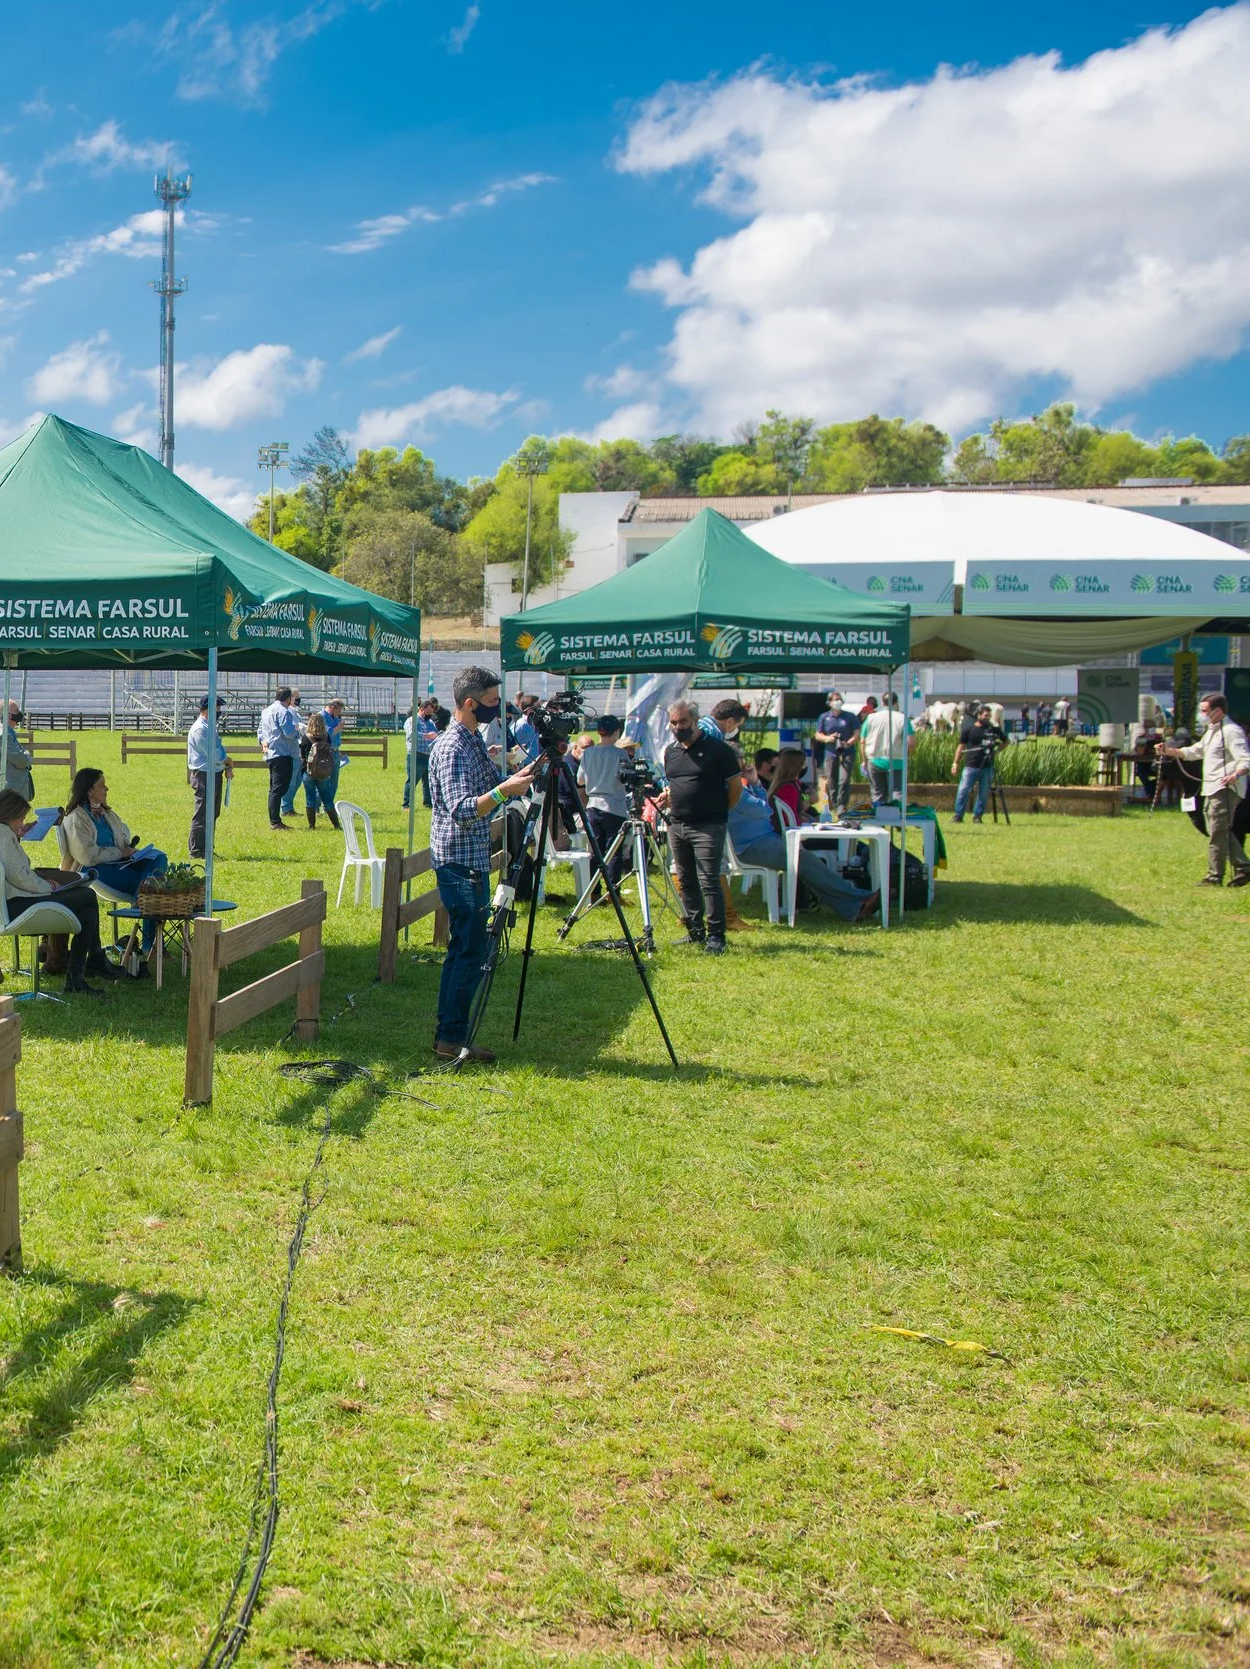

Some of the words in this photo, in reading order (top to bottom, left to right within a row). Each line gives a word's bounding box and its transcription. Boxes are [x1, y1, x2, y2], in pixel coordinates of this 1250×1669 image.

[996, 574, 1020, 583] CNA
[1076, 576, 1100, 584] CNA
[1157, 576, 1182, 584] CNA
[891, 583, 924, 592] SENAR
[996, 583, 1029, 592] SENAR
[1076, 584, 1110, 593] SENAR
[1156, 585, 1192, 593] SENAR
[98, 599, 189, 618] FARSUL
[279, 603, 305, 621] FARSUL
[49, 626, 96, 638] SENAR
[102, 626, 139, 638] CASA
[143, 626, 189, 638] RURAL
[323, 617, 348, 637] SISTEMA
[347, 622, 368, 641] FARSUL
[560, 633, 630, 649] SISTEMA
[632, 630, 695, 646] FARSUL
[748, 629, 822, 644] SISTEMA
[825, 631, 892, 644] FARSUL
[560, 652, 595, 661] FARSUL
[600, 650, 632, 659] SENAR
[636, 649, 662, 658] CASA
[664, 647, 695, 657] RURAL
[748, 646, 785, 656] FARSUL
[789, 646, 825, 657] SENAR
[829, 647, 857, 657] CASA
[858, 648, 892, 657] RURAL
